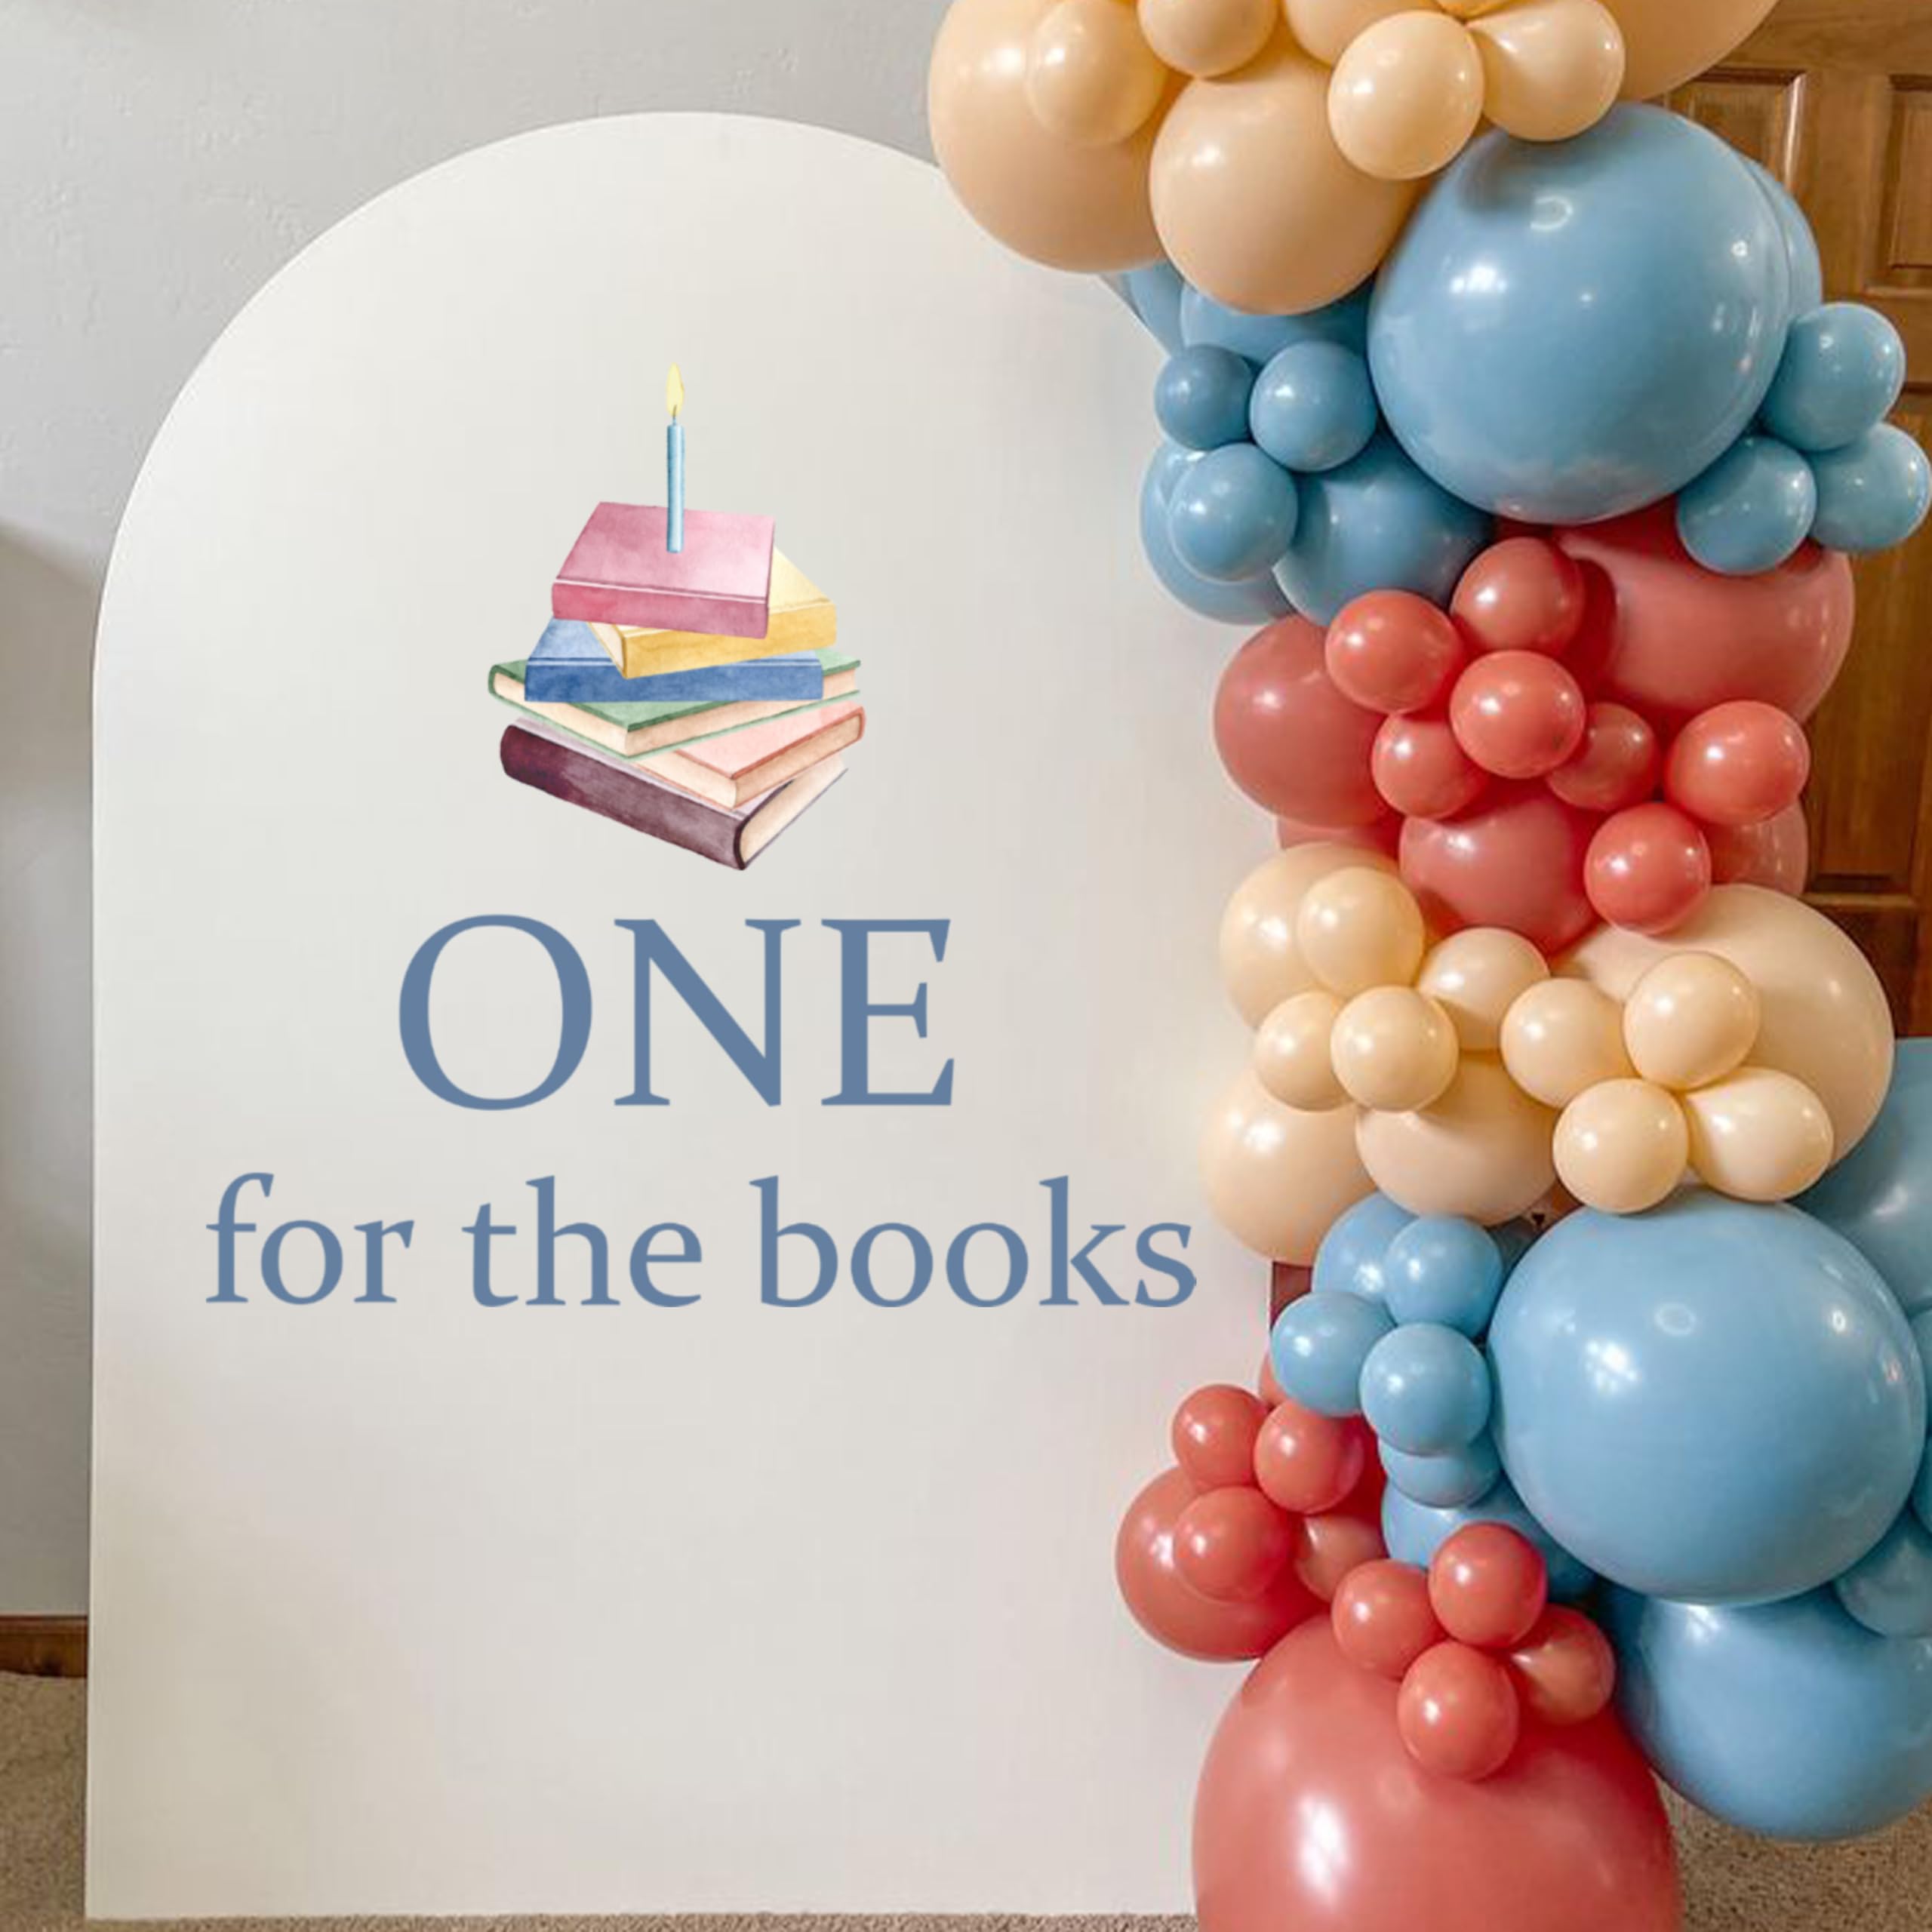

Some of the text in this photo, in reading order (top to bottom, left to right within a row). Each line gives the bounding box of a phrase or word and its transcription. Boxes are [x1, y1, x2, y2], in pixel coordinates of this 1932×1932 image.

[398, 914, 955, 1112] ONE
[205, 1172, 1198, 1308] for the books
